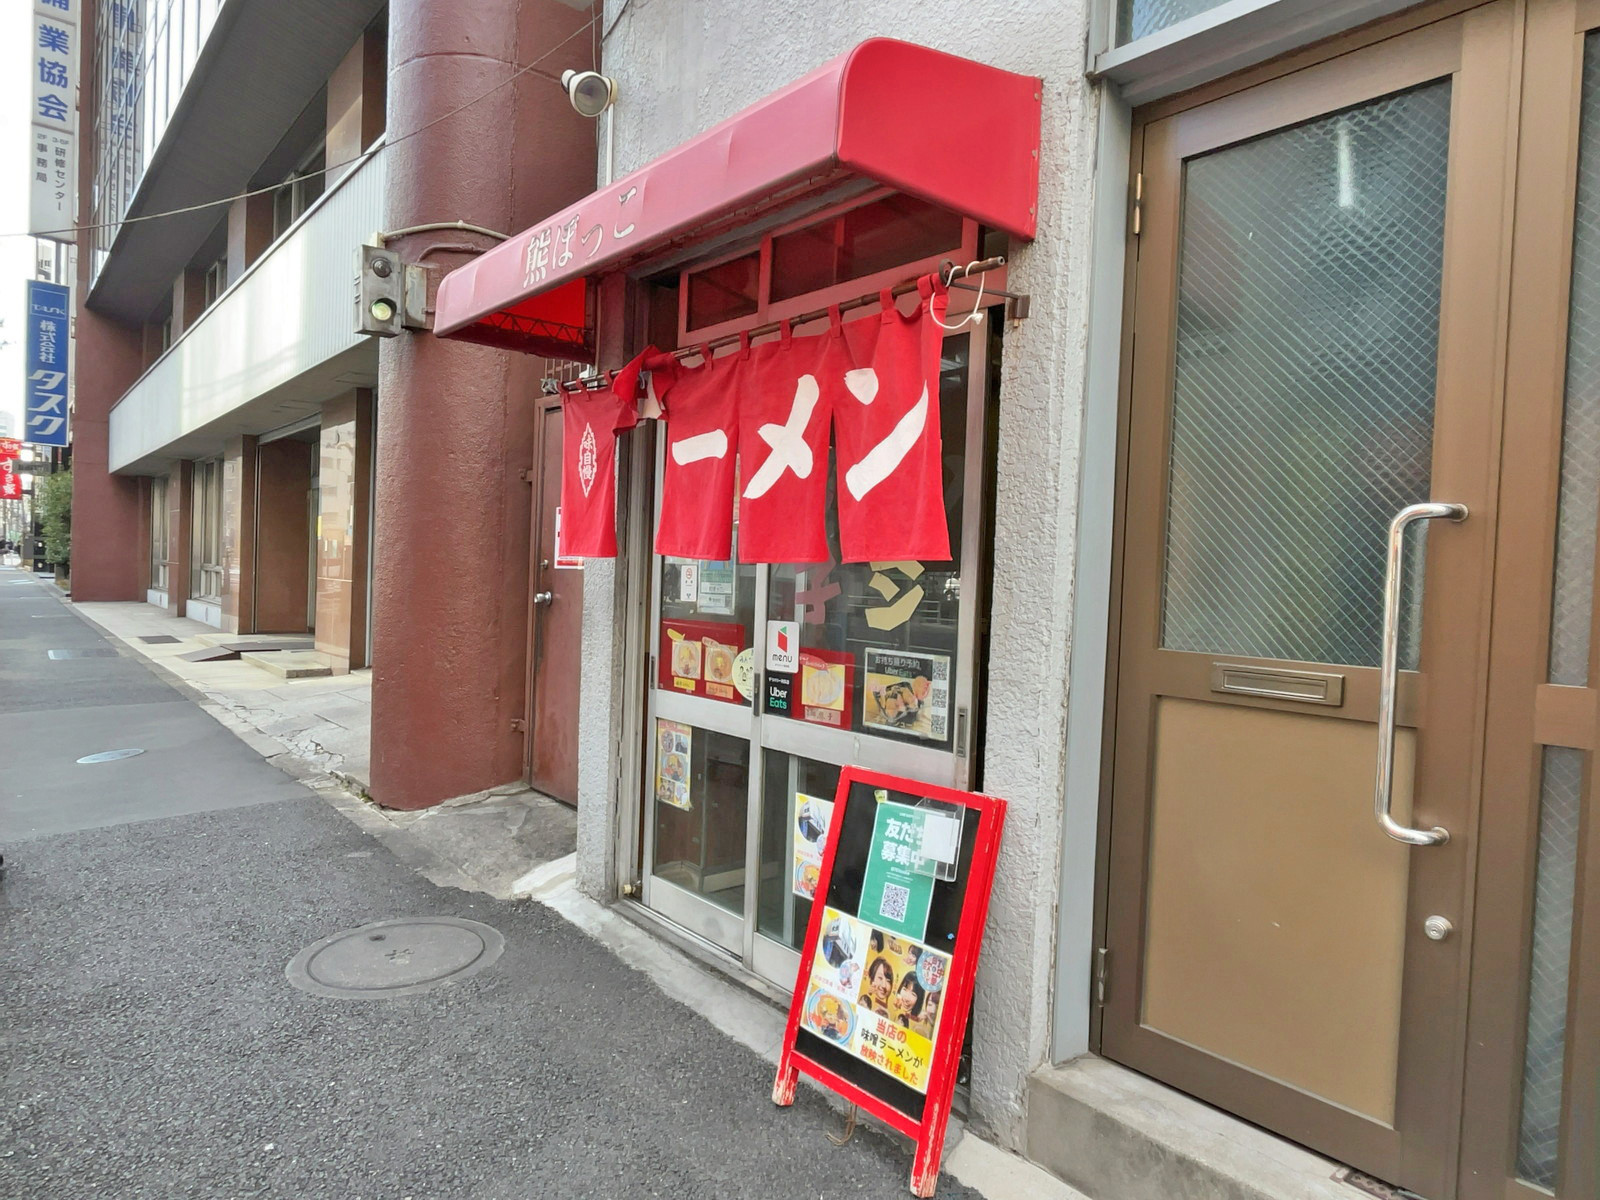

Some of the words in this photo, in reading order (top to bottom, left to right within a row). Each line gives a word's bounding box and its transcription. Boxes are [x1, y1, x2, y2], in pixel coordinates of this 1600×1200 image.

[40, 320, 56, 364] 株式会社
[27, 369, 66, 436] タスク
[772, 654, 793, 663] menu
[769, 697, 787, 710] Eats
[770, 686, 787, 698] Uber
[876, 1018, 907, 1044] 当店の
[861, 1028, 923, 1068] 味噌ラーメンが
